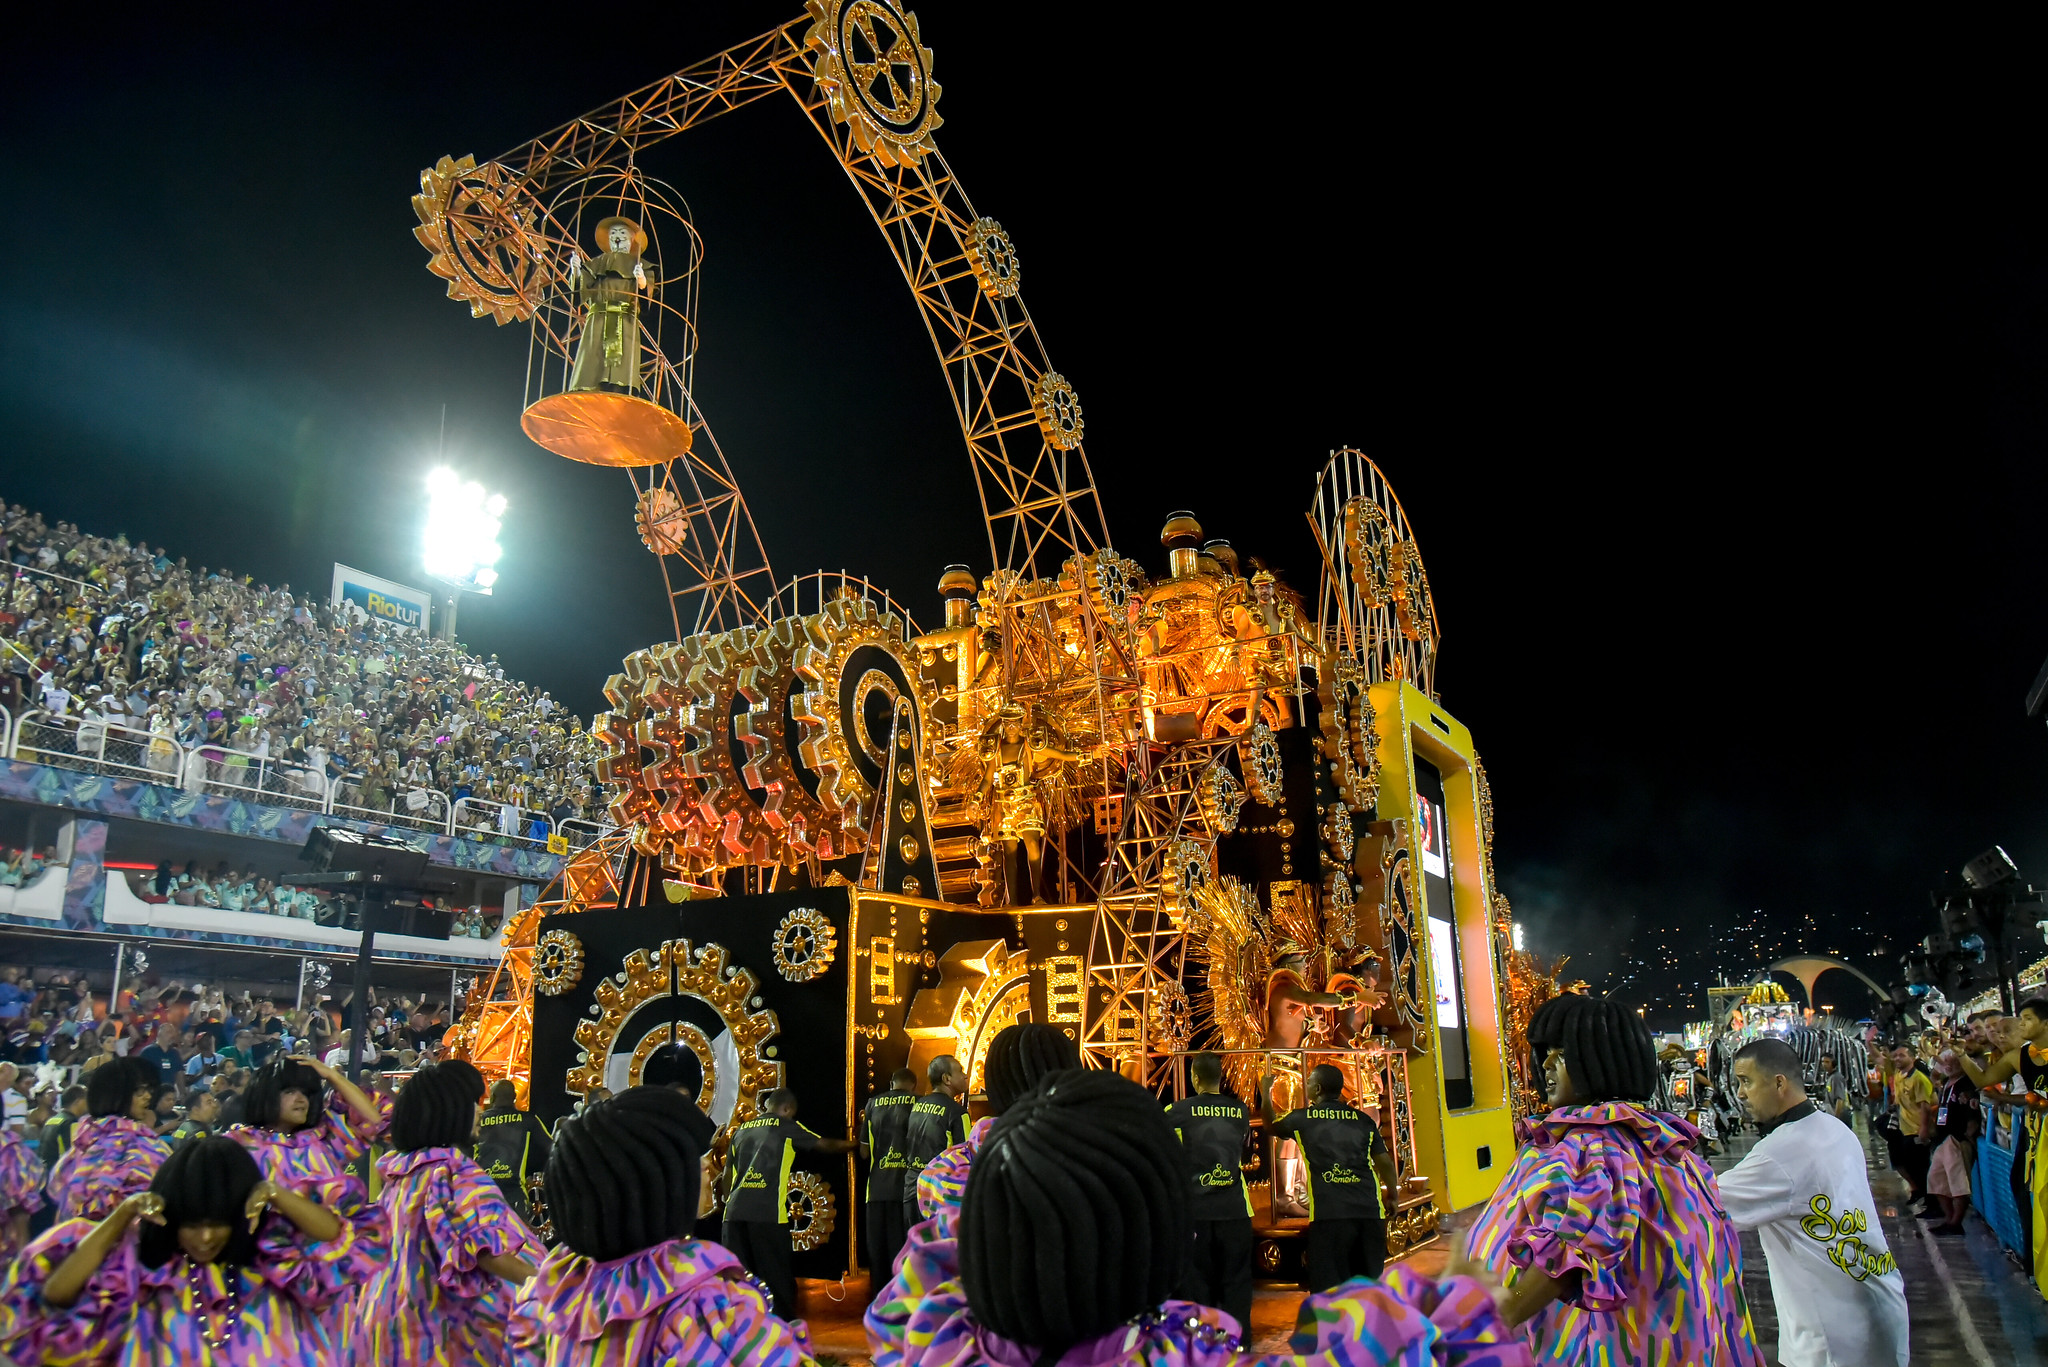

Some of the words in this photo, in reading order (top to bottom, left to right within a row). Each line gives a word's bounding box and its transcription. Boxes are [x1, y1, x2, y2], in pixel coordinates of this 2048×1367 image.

[368, 592, 420, 625] Riotur
[348, 872, 356, 881] 17
[373, 874, 382, 882] 17
[1191, 1104, 1243, 1119] LOGÍSTICA
[1306, 1108, 1359, 1121] LOGÍSTICA
